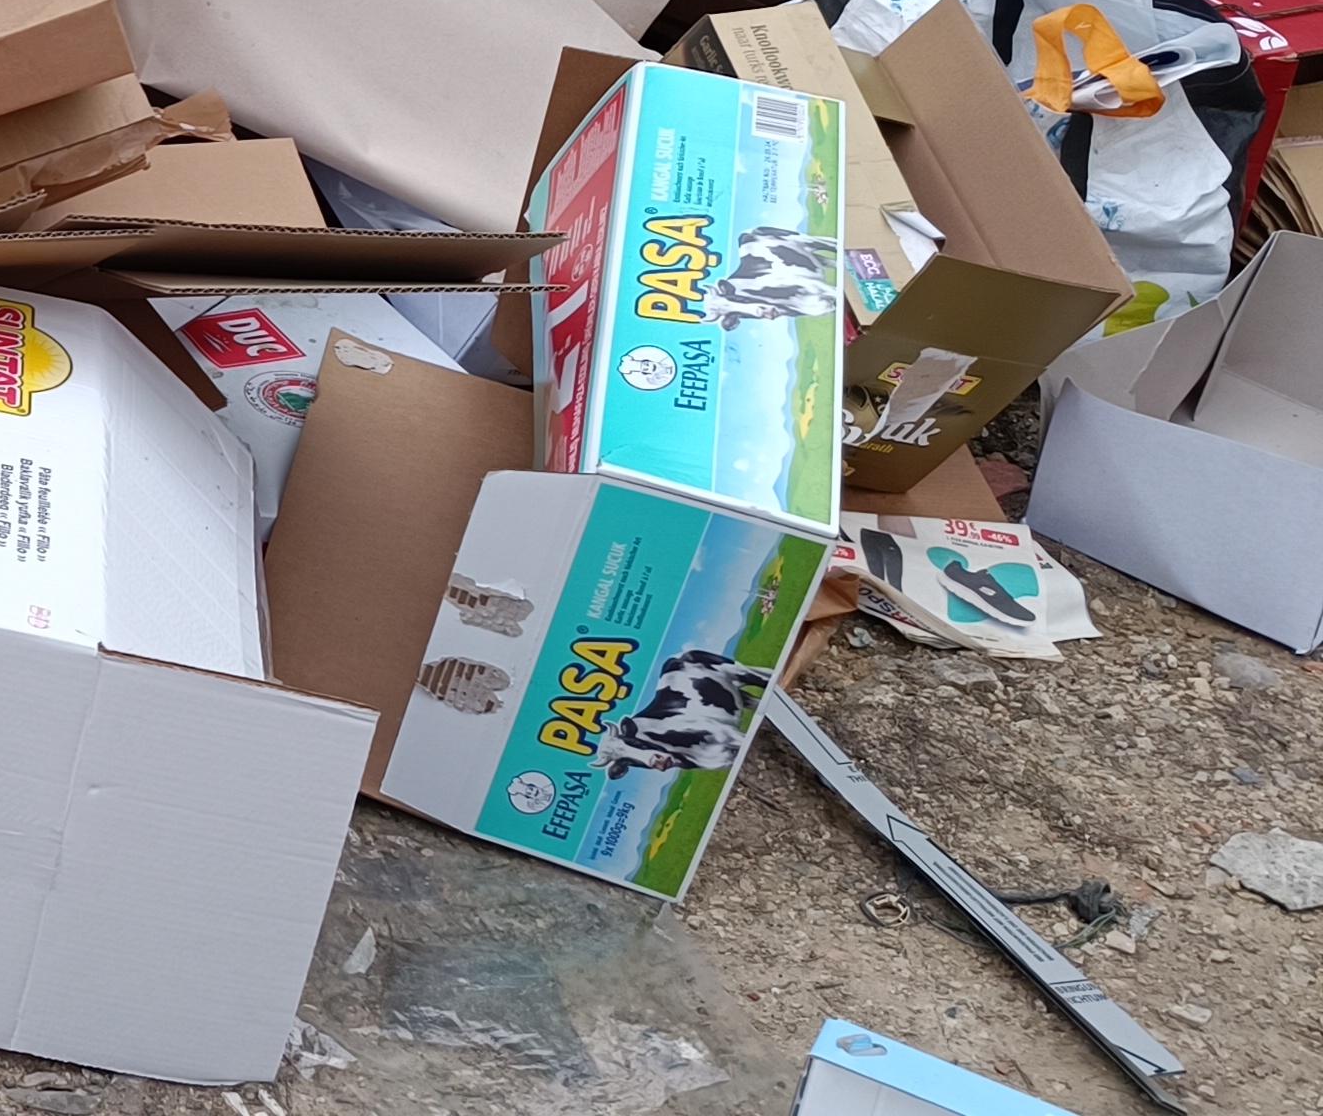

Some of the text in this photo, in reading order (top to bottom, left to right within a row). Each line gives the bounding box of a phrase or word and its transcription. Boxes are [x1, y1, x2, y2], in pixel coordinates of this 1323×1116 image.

[731, 26, 752, 49] naar
[743, 50, 766, 73] turks
[749, 24, 793, 89] Knoflookwo
[634, 214, 715, 324] PAŞA
[228, 315, 287, 360] DUC
[586, 541, 627, 619] KANGAL SUCUK
[537, 636, 640, 756] PAŞA
[541, 769, 594, 842] EFEPAŞA
